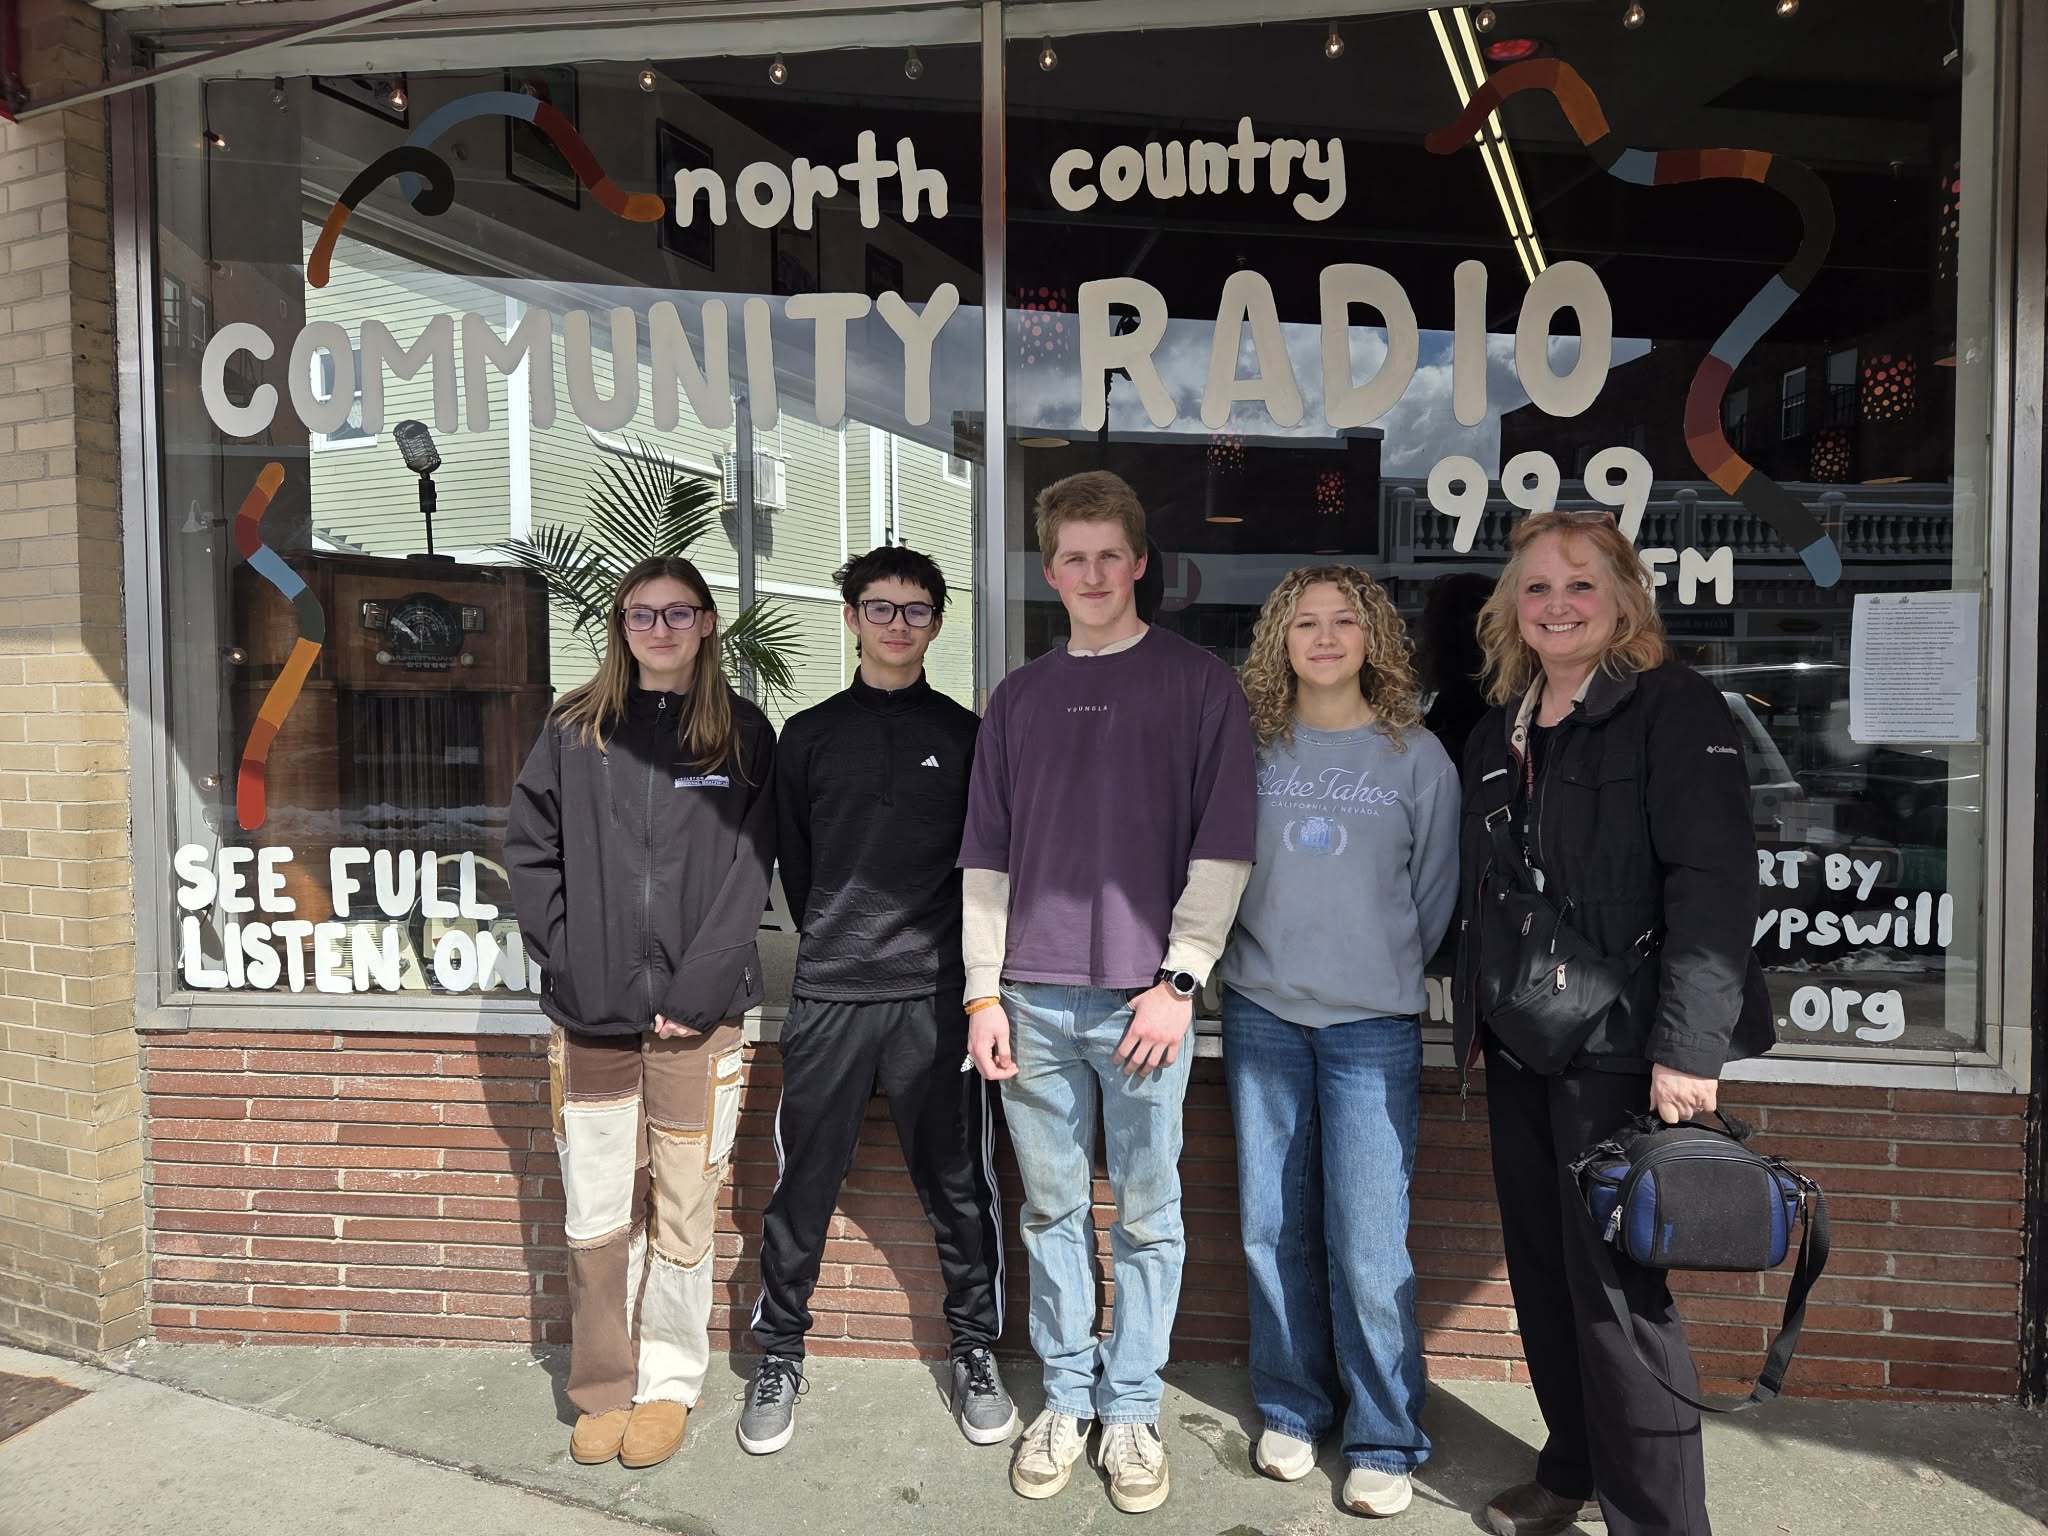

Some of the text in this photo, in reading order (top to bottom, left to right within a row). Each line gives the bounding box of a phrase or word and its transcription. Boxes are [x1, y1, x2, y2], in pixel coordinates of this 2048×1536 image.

[675, 129, 949, 229] north
[1050, 116, 1346, 222] country
[201, 259, 1613, 437] COMMUNITY RADIO
[1639, 546, 1734, 606] FM
[1066, 704, 1108, 713] YOUNGLA
[1256, 764, 1400, 806] Lake Tahoe
[1271, 801, 1328, 812] CALIFORNIA
[1341, 807, 1380, 816] NEVADA
[174, 843, 498, 921] SEE FULL
[1757, 849, 1882, 901] RT BY
[181, 916, 402, 994] LISTEN
